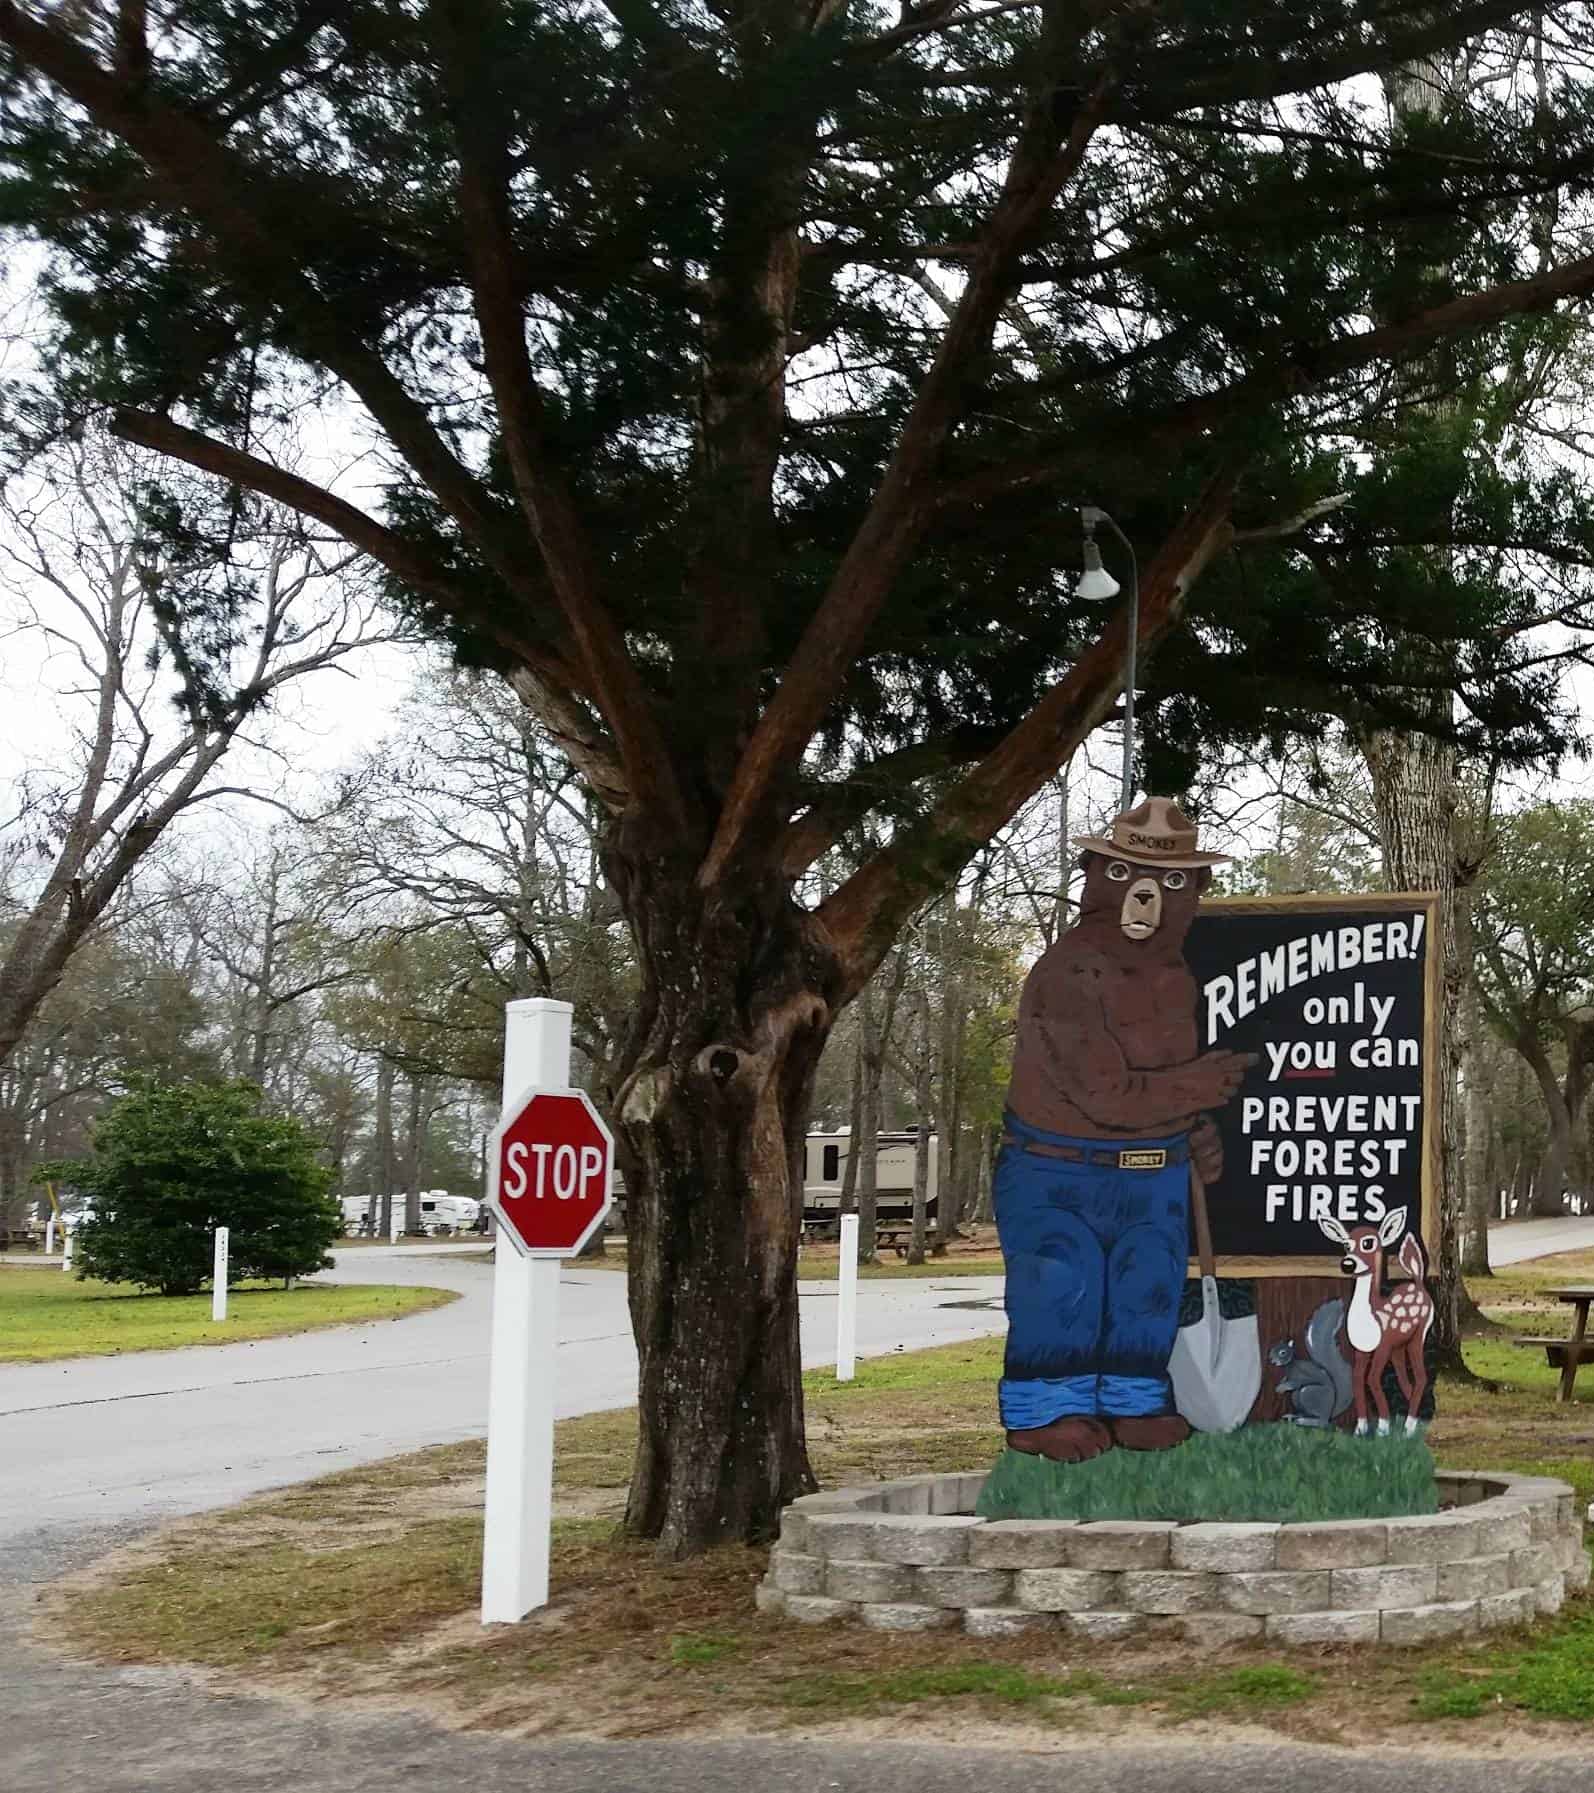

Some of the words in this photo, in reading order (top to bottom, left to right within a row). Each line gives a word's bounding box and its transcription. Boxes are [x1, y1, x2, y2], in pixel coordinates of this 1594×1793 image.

[1127, 832, 1176, 850] SMOKEY
[1203, 914, 1425, 1045] REMEMBER!
[1302, 982, 1396, 1036] only
[1264, 1041, 1336, 1081] you
[1349, 1037, 1419, 1068] can
[1241, 1095, 1421, 1134] PREVENT
[503, 1141, 603, 1200] STOP
[1250, 1138, 1407, 1178] FOREST
[1265, 1184, 1387, 1222] FIRES
